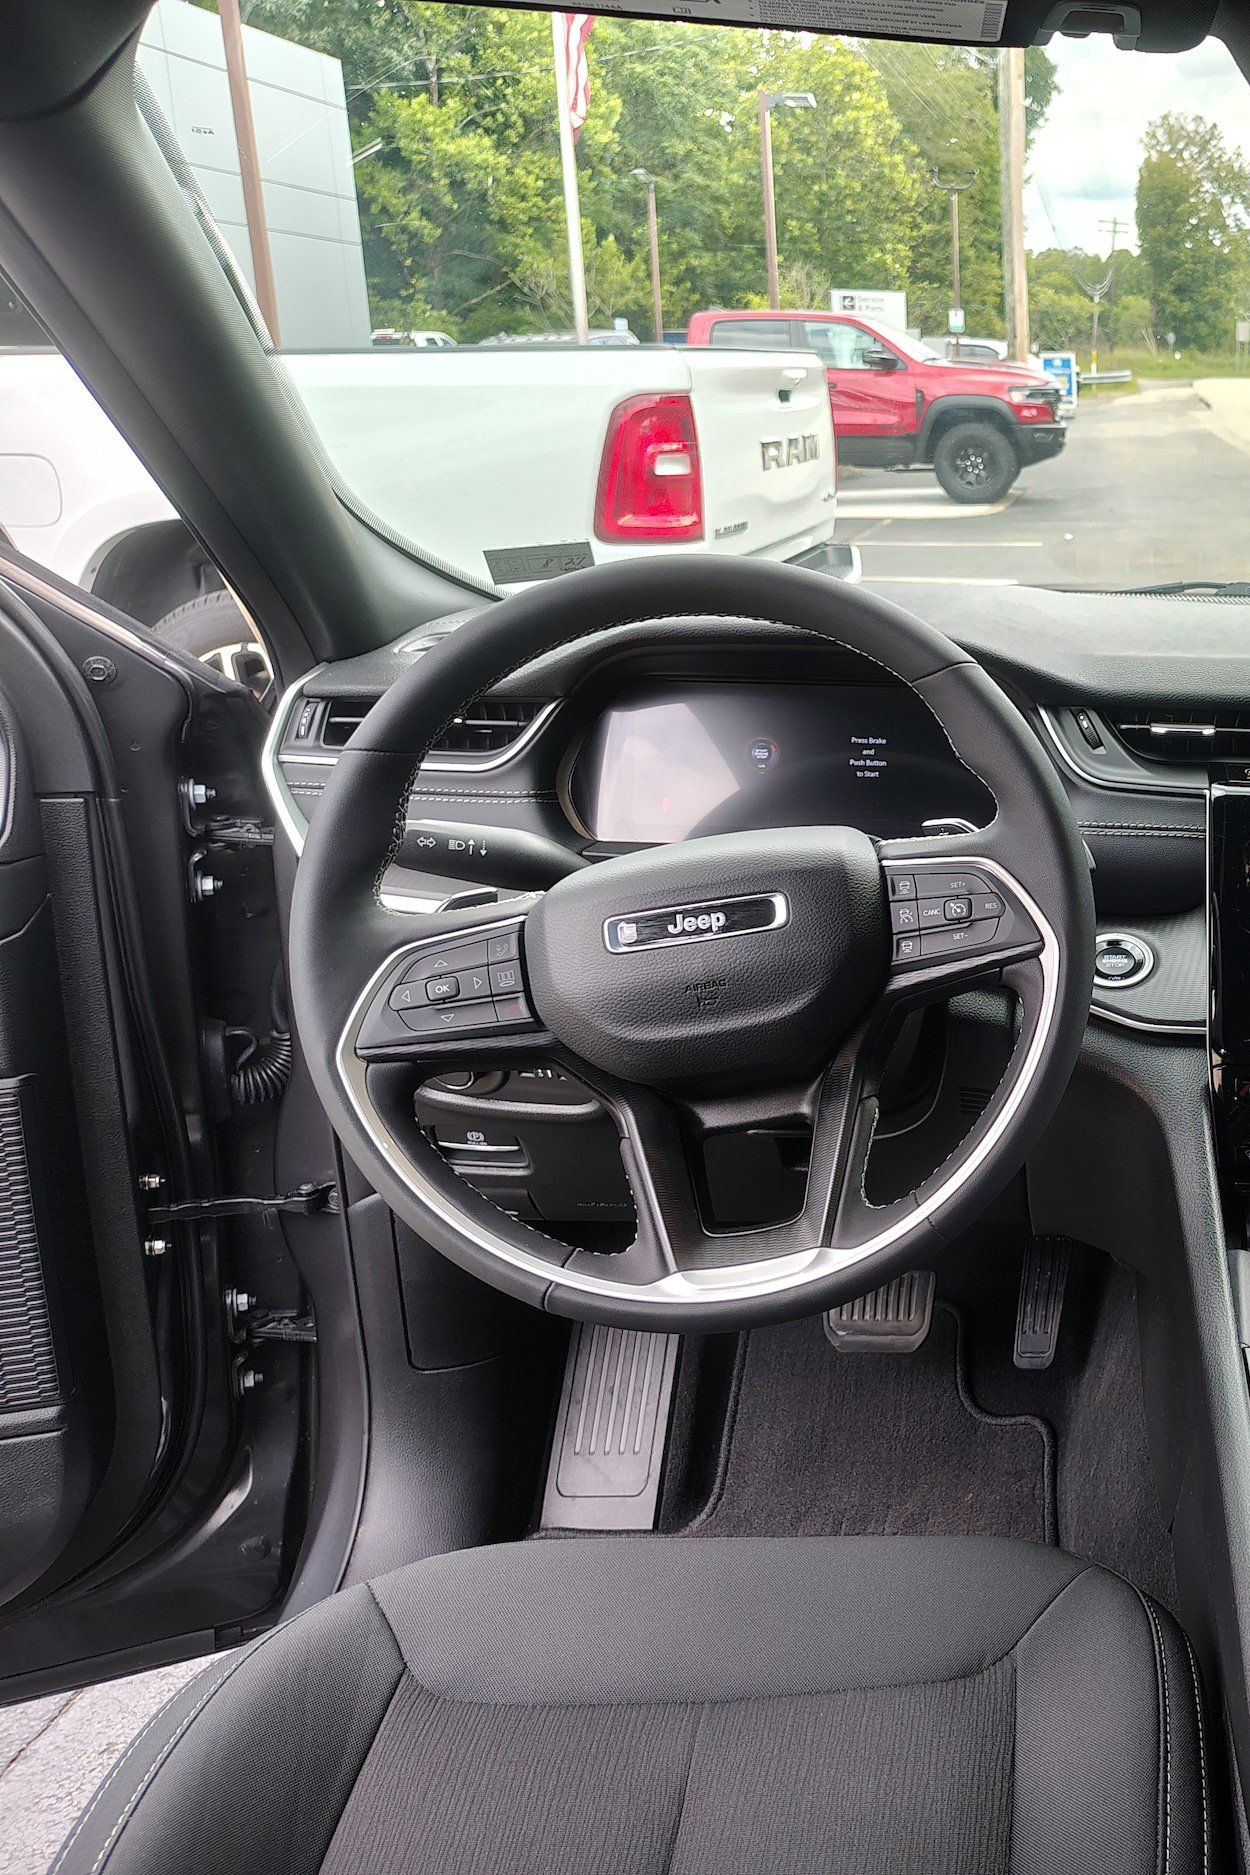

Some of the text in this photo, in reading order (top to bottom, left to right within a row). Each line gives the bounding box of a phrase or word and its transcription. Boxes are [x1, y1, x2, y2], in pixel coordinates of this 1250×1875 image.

[760, 434, 820, 472] RAM
[923, 908, 941, 916] CANC
[667, 911, 726, 934] Jeep
[435, 984, 451, 994] OK
[684, 978, 727, 993] AIRBAG
